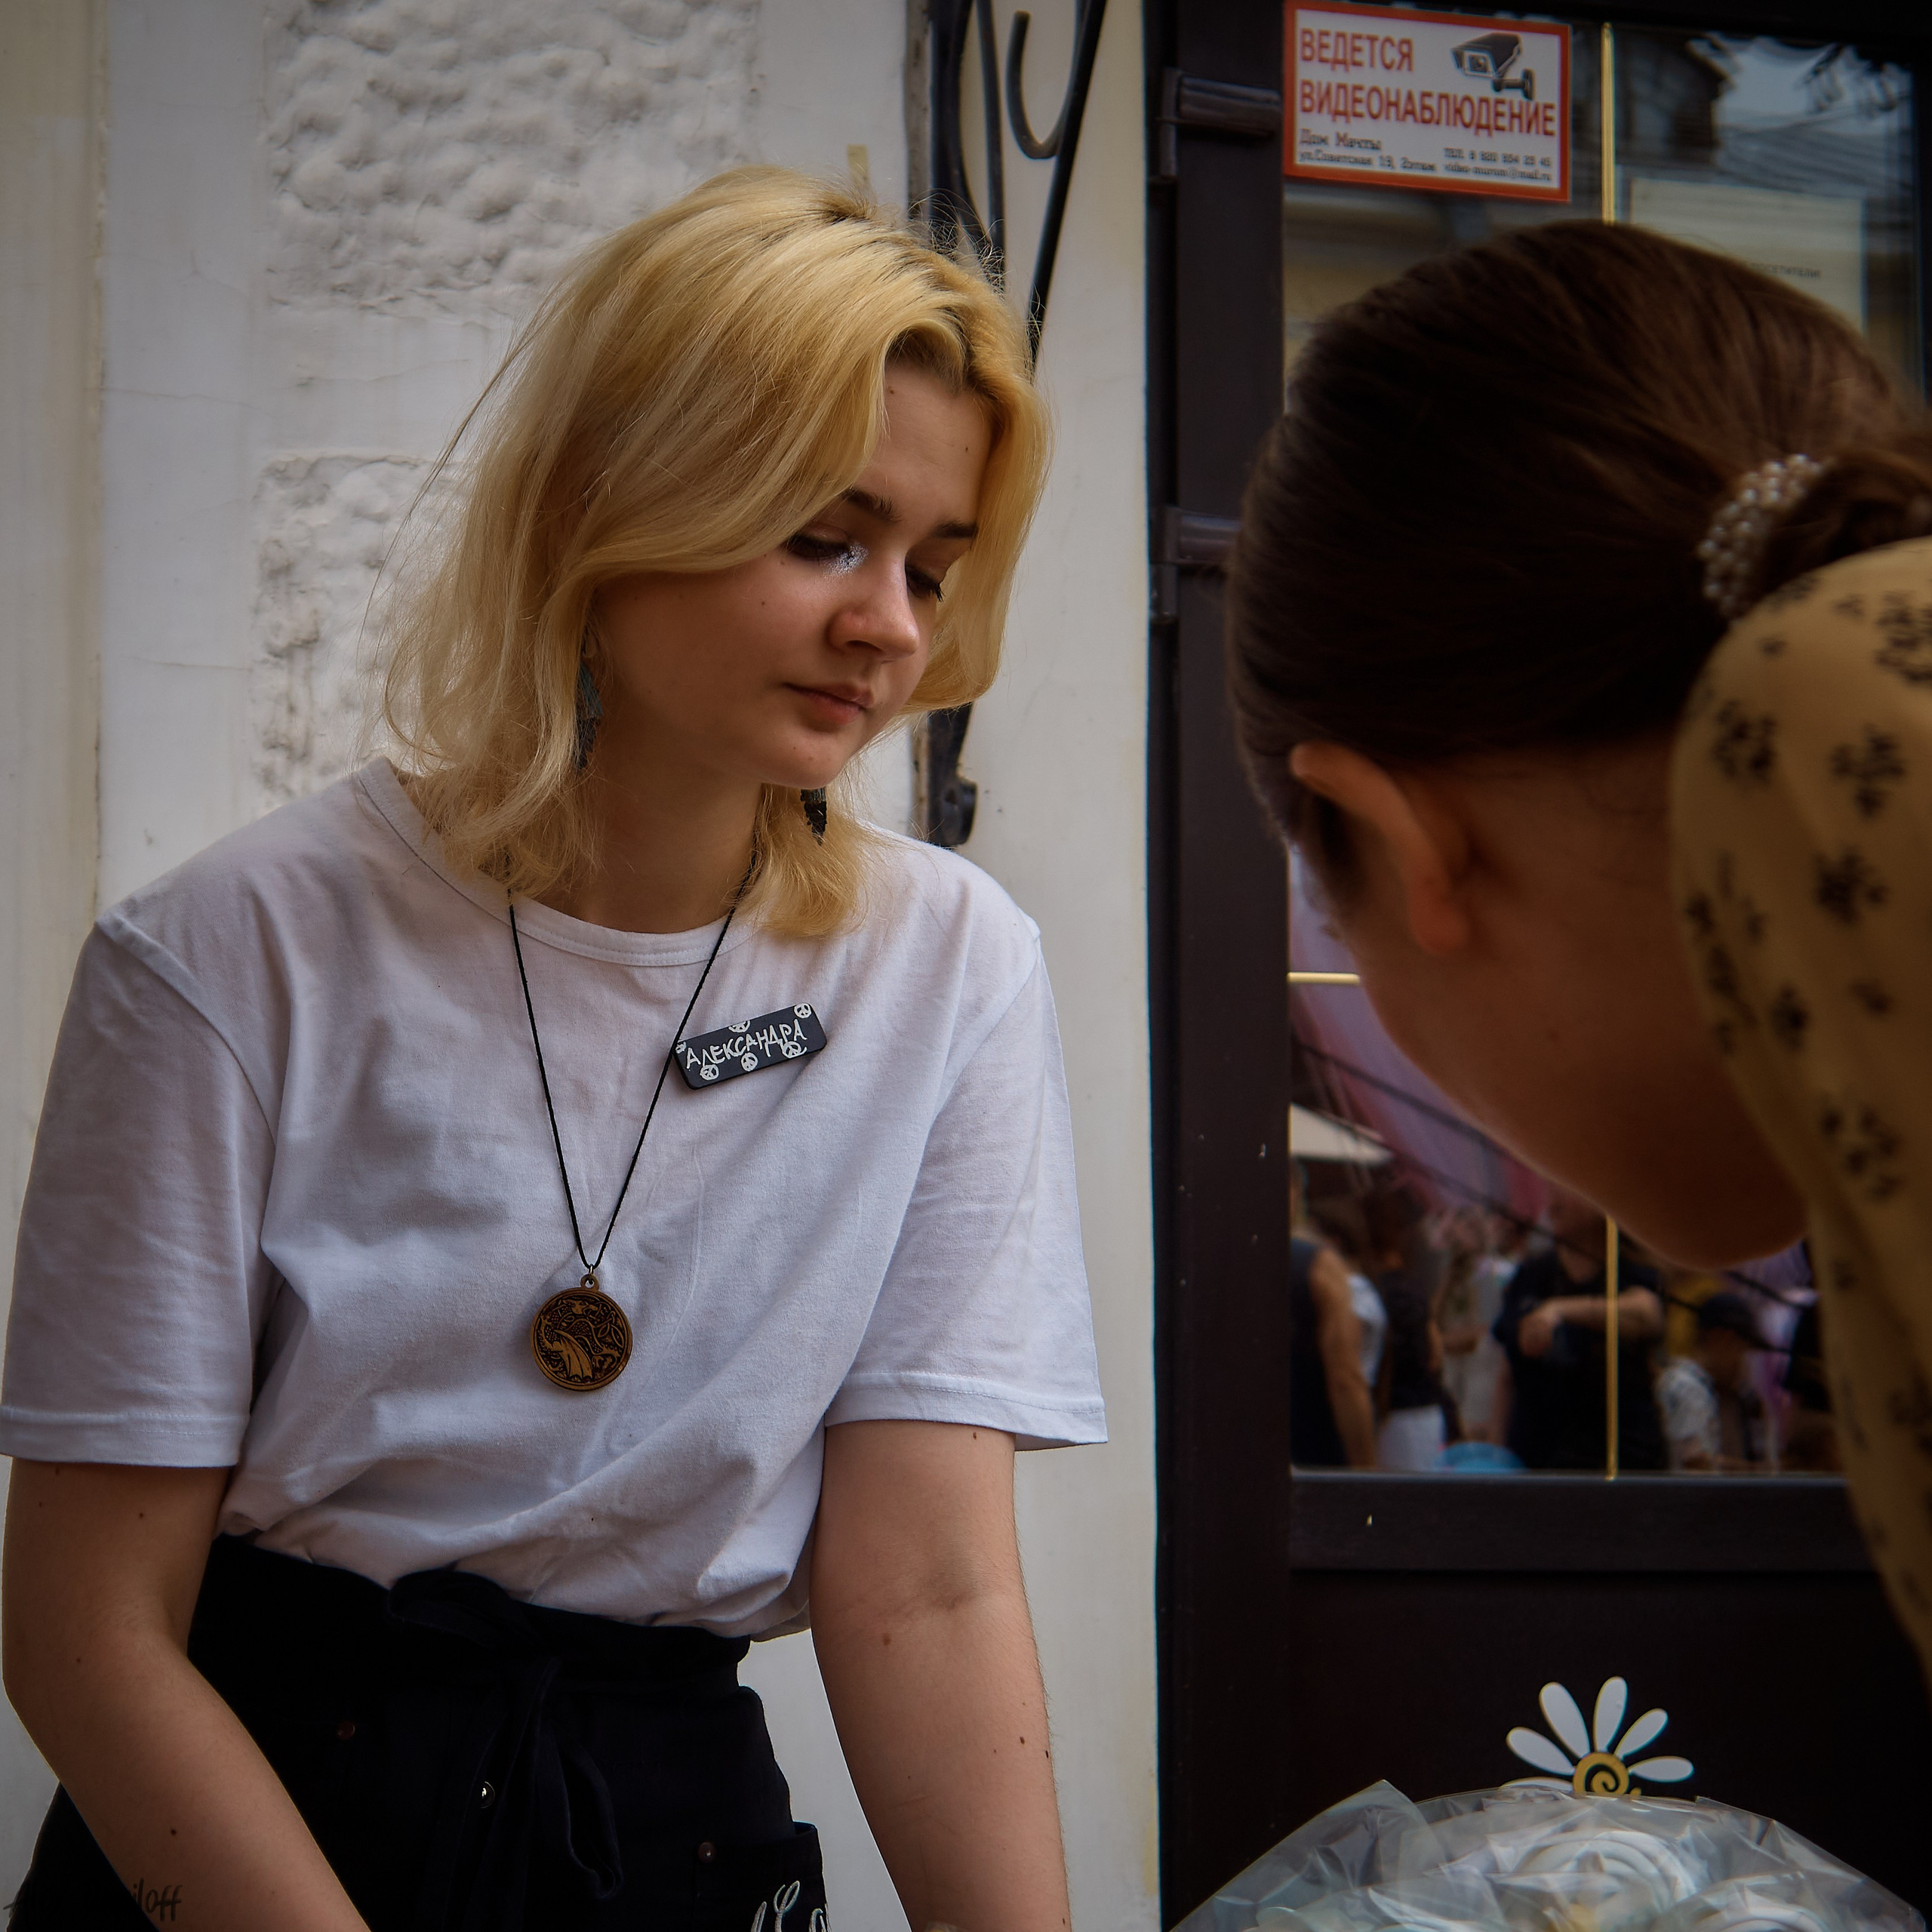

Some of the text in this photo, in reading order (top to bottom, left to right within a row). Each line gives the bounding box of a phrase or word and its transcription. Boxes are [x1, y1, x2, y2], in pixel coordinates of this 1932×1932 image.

[1300, 28, 1413, 72] ВЕДЕТСЯ
[1300, 80, 1555, 137] ВИДЕОНАБЛЮДЕНИЕ
[1300, 128, 1382, 150] Дом Мечты
[686, 1019, 808, 1069] АЛЕКСАНДРА
